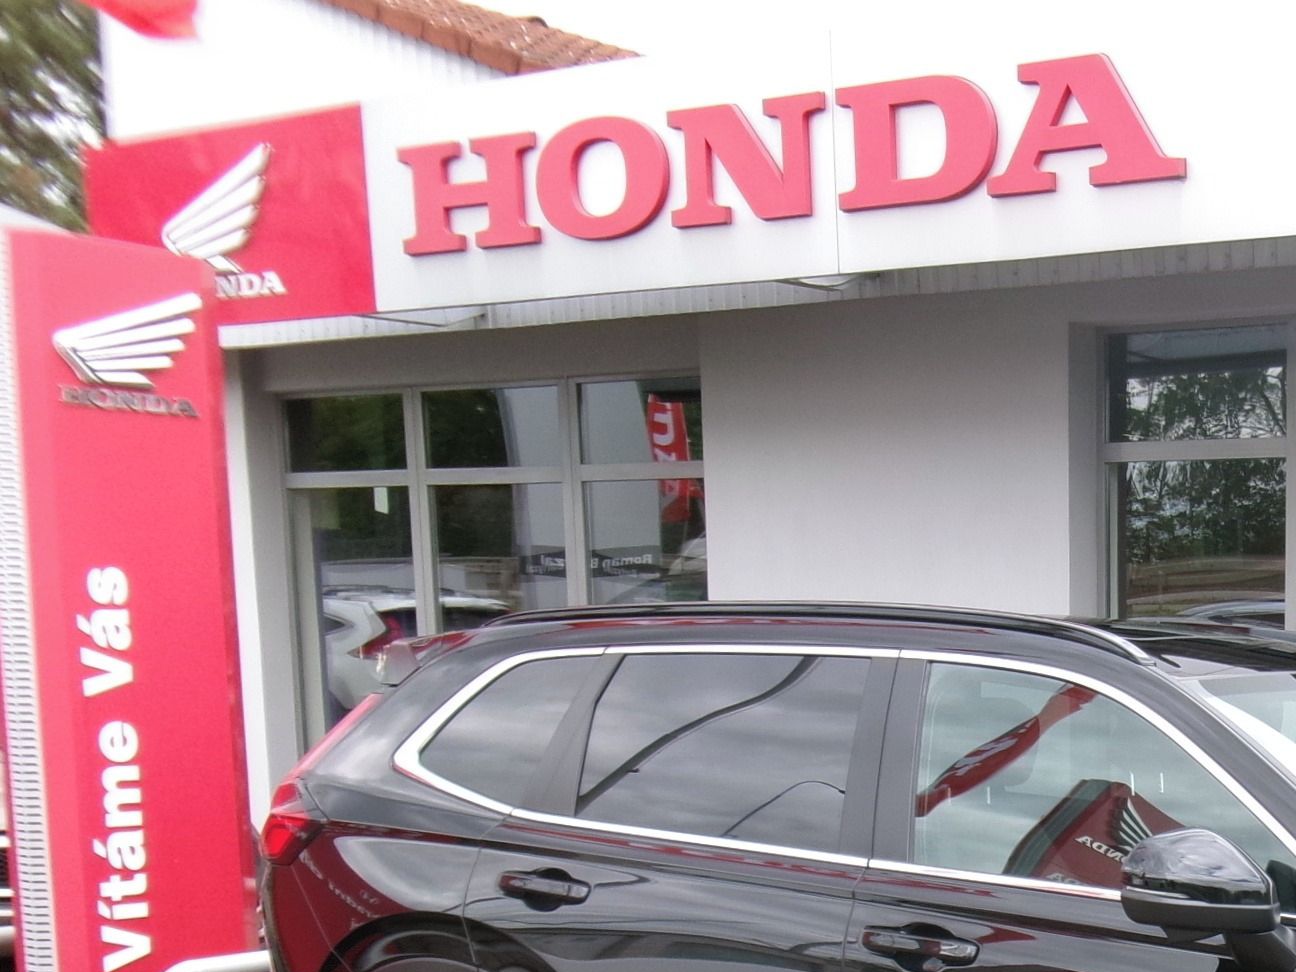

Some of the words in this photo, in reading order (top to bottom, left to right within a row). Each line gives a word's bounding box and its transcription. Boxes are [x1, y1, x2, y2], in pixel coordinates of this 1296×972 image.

[396, 53, 1188, 258] HONDA
[214, 271, 288, 299] NDA
[57, 384, 199, 418] HONDA
[76, 565, 136, 698] Vás
